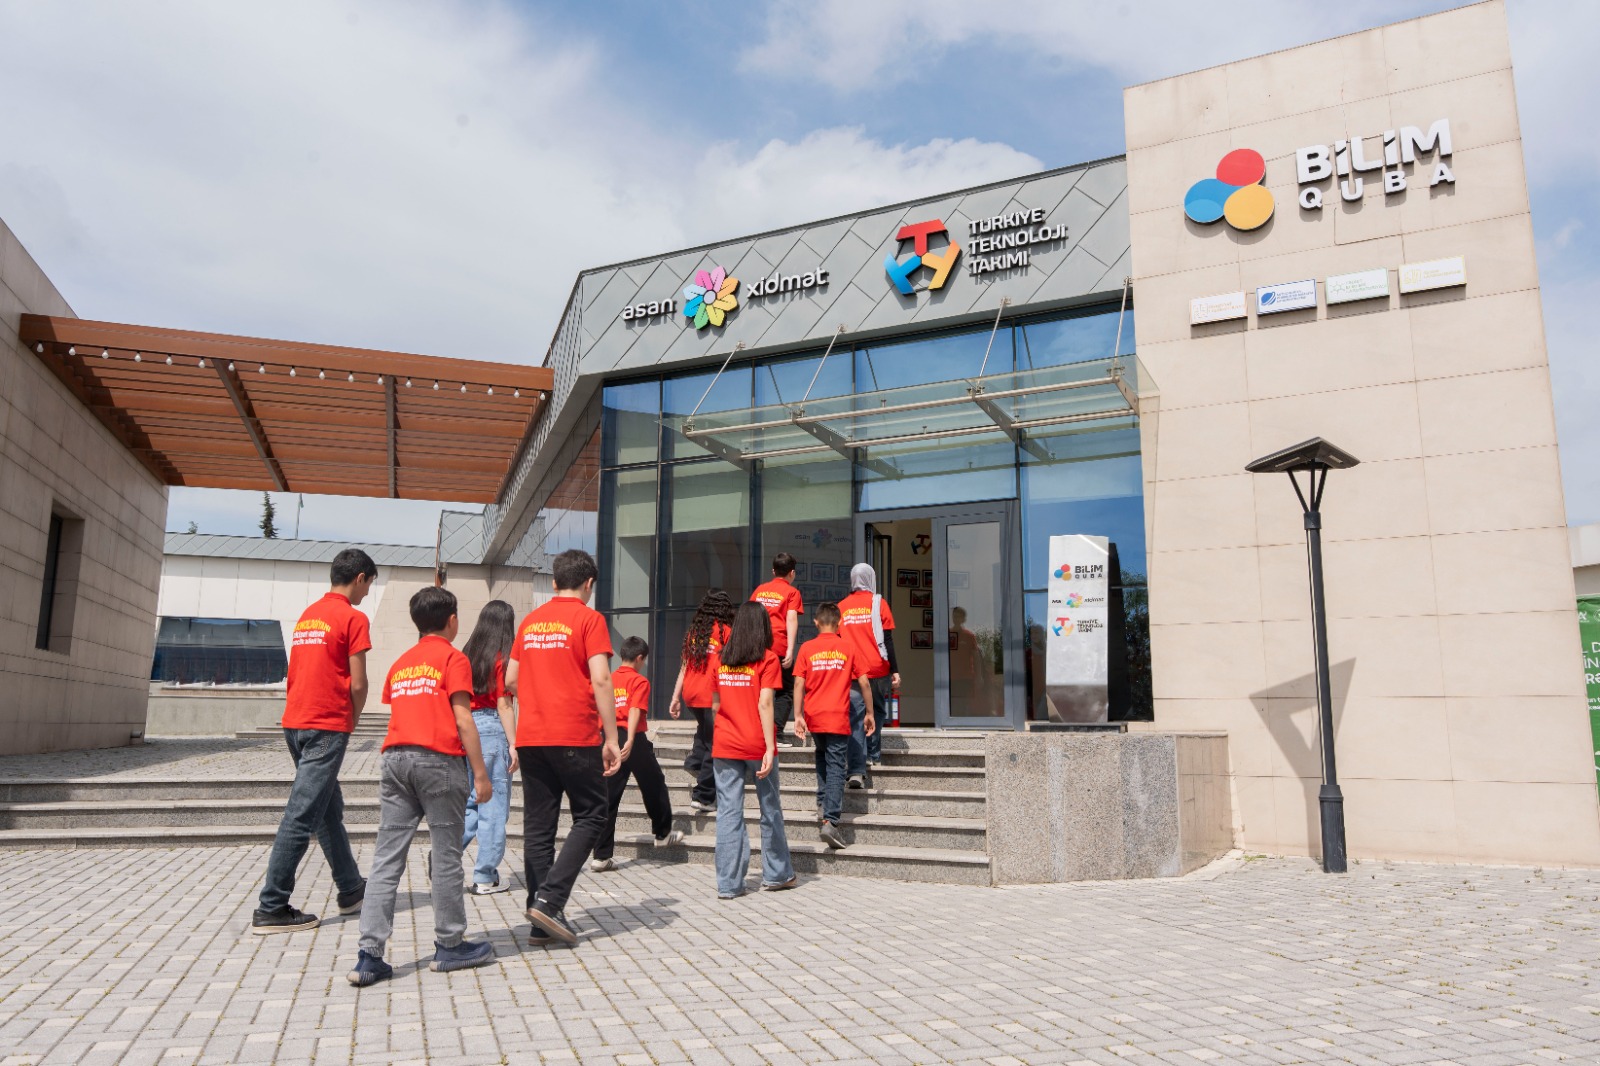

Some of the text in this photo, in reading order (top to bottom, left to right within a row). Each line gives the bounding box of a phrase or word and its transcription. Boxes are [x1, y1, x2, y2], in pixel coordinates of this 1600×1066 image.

[1296, 118, 1453, 184] BİLİM
[1299, 162, 1456, 210] QUBA
[969, 207, 1043, 234] TÜRKİYE
[969, 223, 1066, 254] TEKNOLOJİ
[969, 250, 1029, 274] TAKIMI
[622, 266, 827, 320] asan xidmət
[1075, 565, 1103, 573] BİLİM
